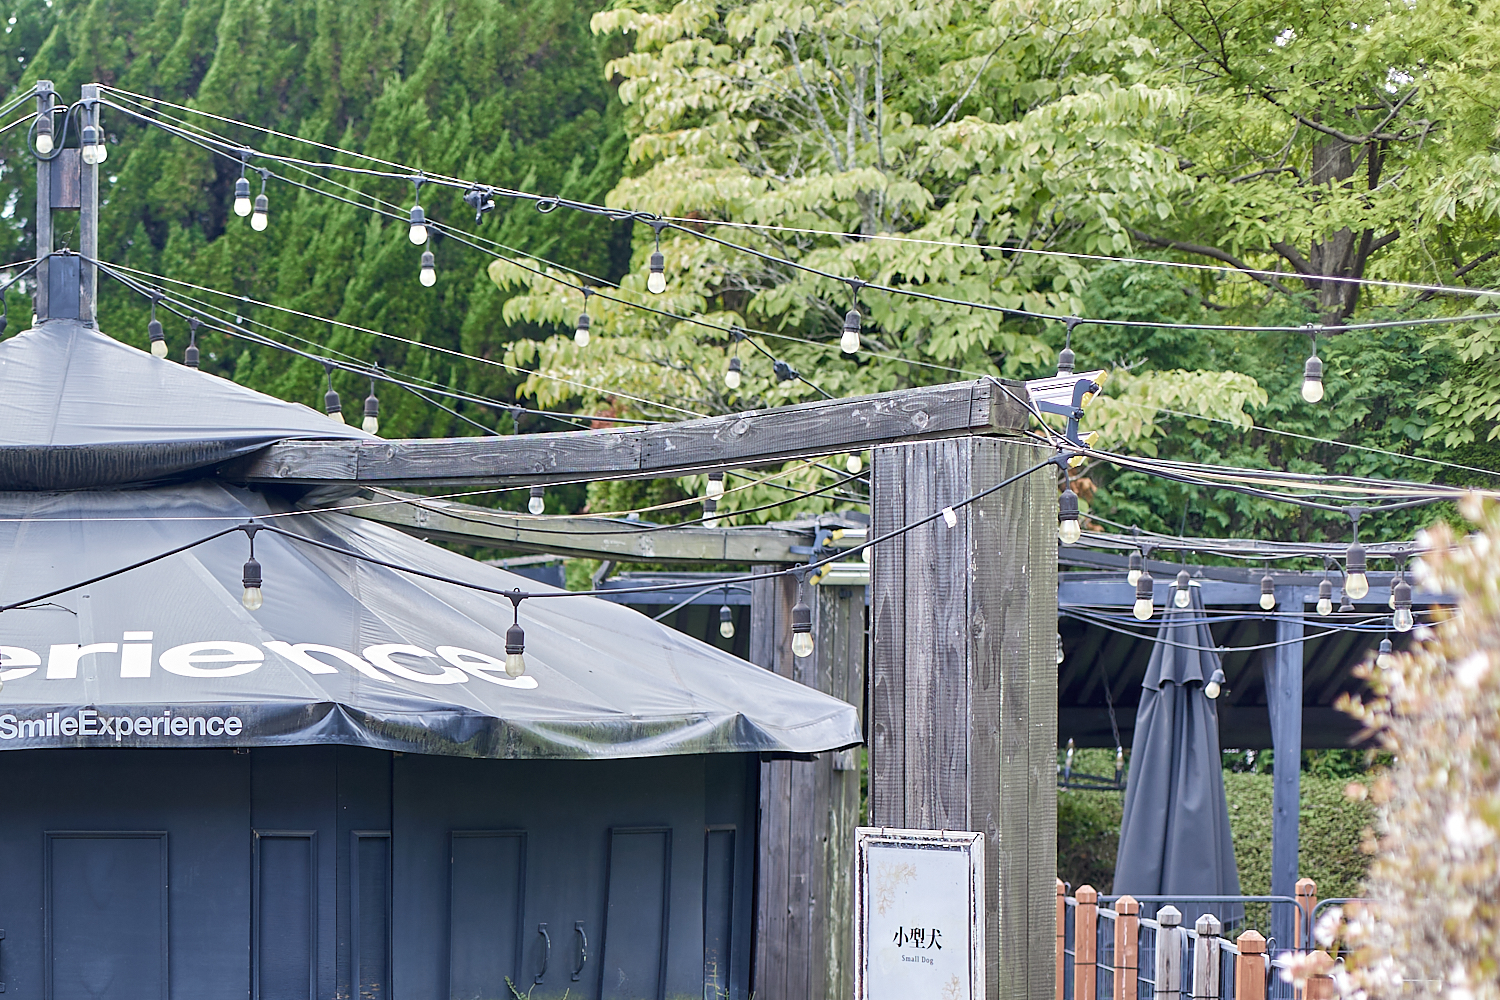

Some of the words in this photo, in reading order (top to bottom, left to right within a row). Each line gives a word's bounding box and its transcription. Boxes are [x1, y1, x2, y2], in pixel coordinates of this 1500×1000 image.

[892, 926, 943, 950] 小型犬
[901, 954, 920, 963] Small
[921, 956, 934, 966] Dog
